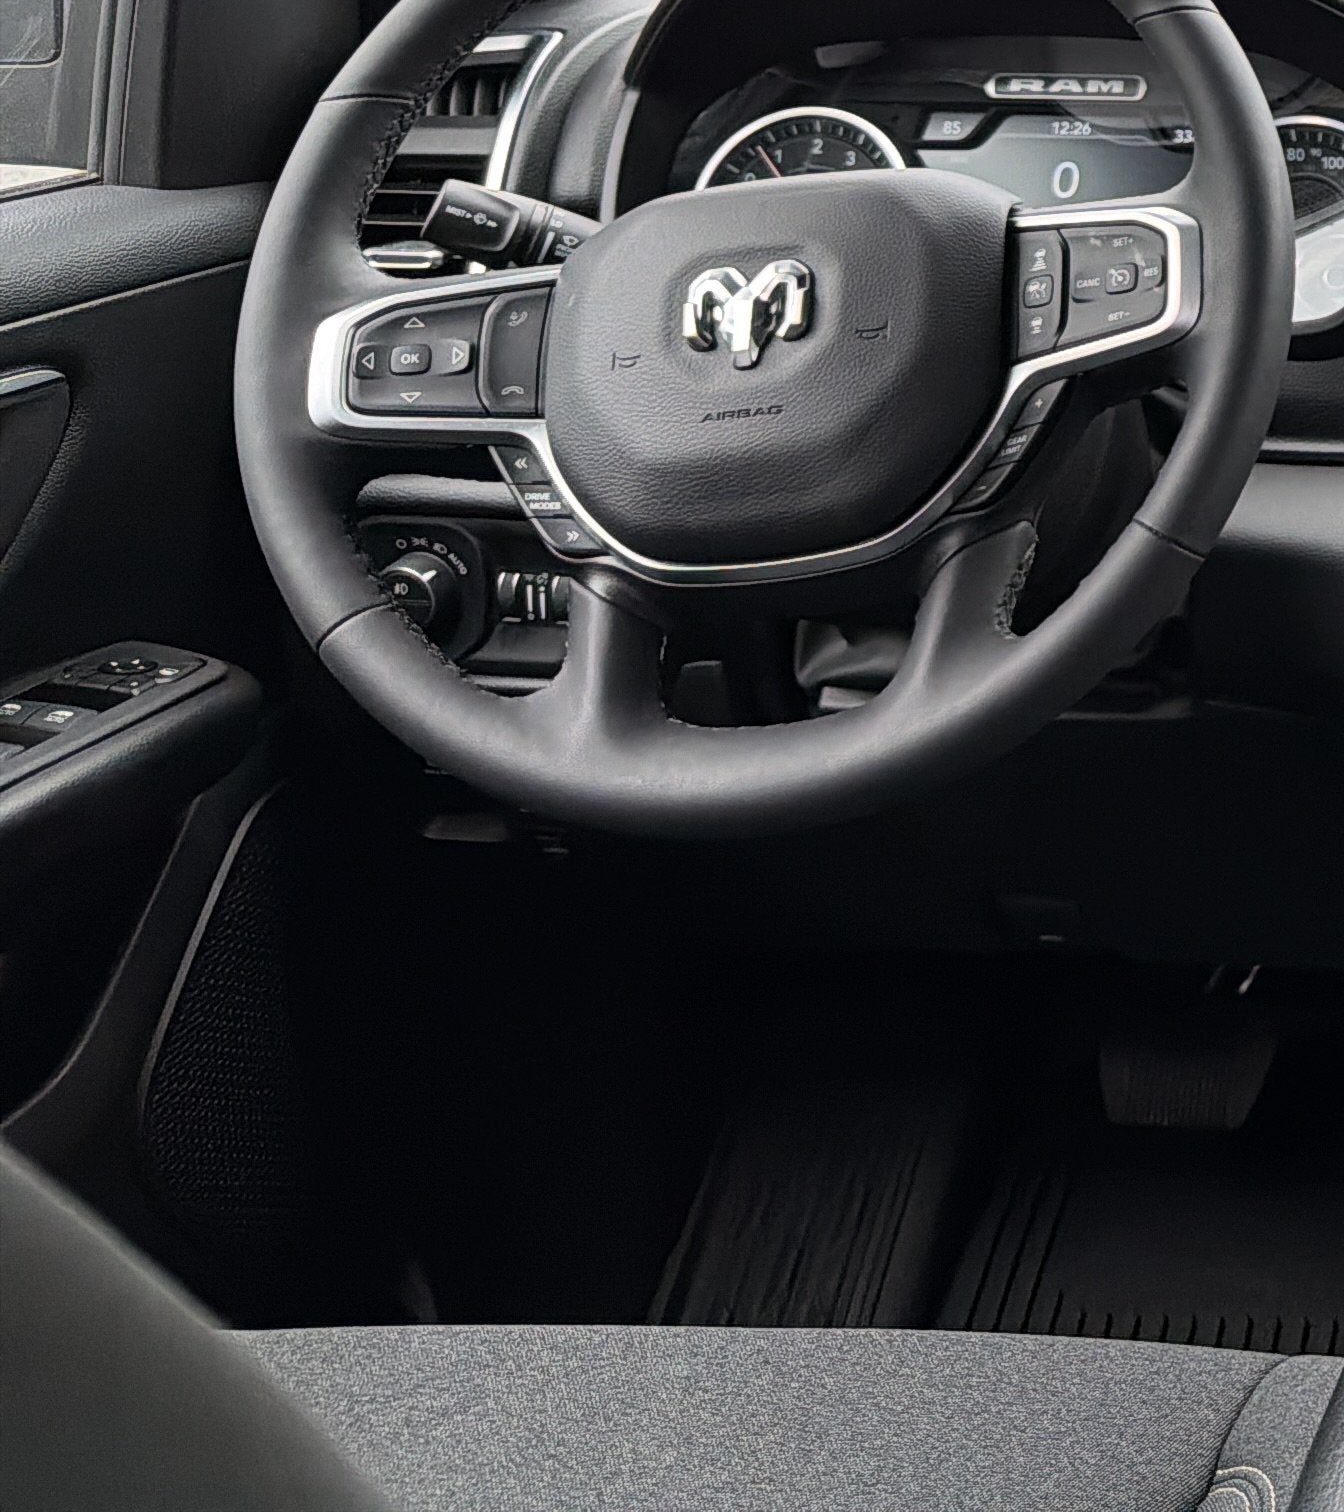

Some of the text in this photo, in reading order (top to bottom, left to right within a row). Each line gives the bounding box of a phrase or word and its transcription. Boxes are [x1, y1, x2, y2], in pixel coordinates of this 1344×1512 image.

[1008, 76, 1126, 94] RAM
[942, 121, 961, 135] 85
[1051, 121, 1091, 135] 12:26
[811, 138, 824, 155] 2
[774, 148, 783, 164] 1
[844, 150, 857, 167] 3
[1287, 147, 1305, 161] 80
[1321, 156, 1344, 170] 100
[1052, 160, 1080, 199] 0
[399, 353, 420, 365] OK
[699, 403, 786, 424] AIRBAG
[524, 492, 551, 501] DRIVE
[529, 501, 562, 510] MODES
